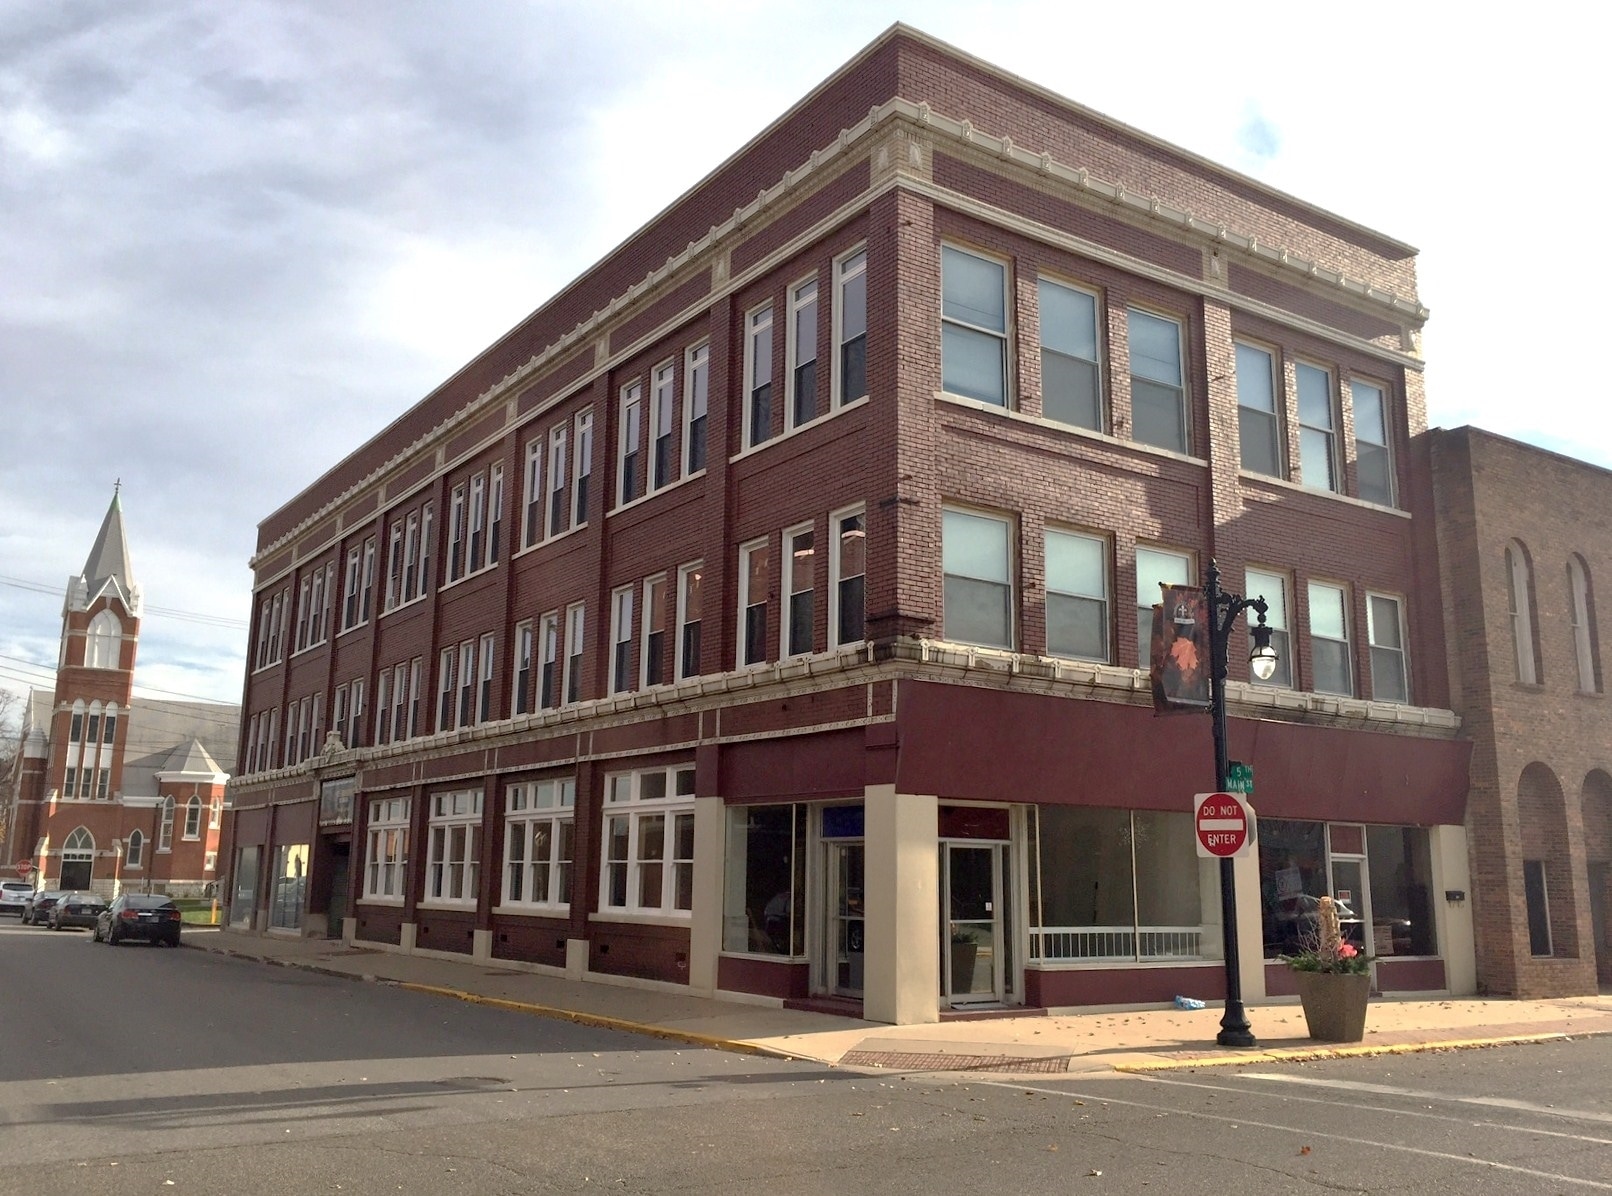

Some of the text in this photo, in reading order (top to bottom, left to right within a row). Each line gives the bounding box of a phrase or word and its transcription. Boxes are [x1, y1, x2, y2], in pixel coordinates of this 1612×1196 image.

[1227, 779, 1244, 790] MAIN
[1203, 805, 1237, 816] DO NOT
[1207, 834, 1237, 844] ENTER
